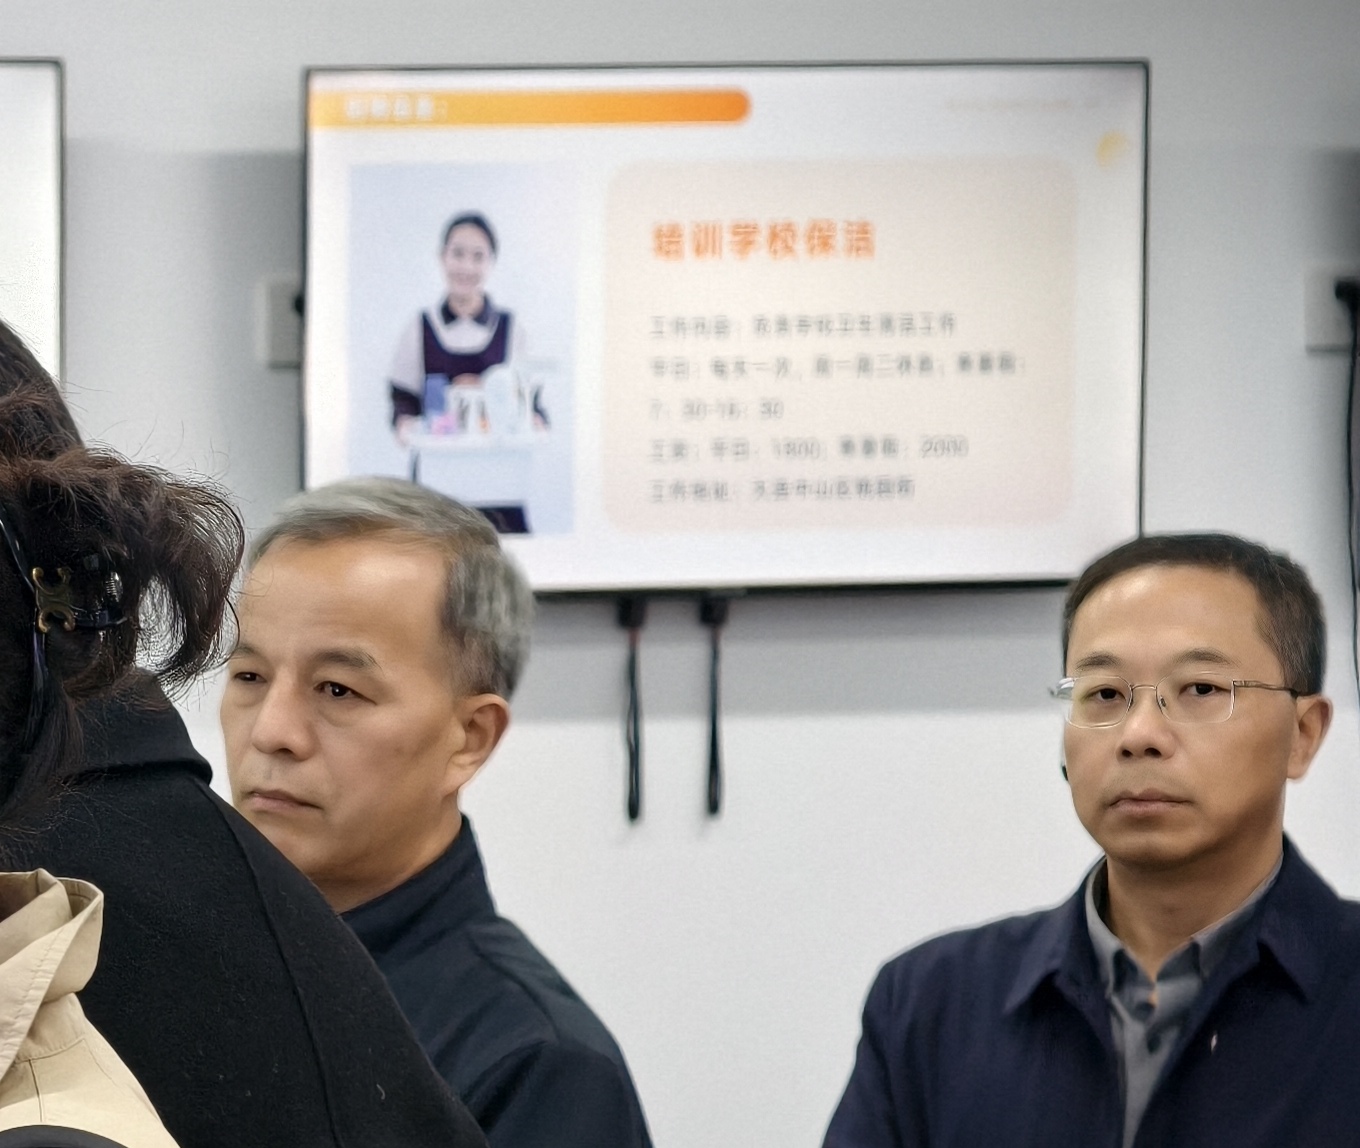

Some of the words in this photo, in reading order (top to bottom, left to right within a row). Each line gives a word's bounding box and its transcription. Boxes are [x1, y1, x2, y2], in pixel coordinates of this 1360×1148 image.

[651, 220, 877, 261] 培训学校保洁
